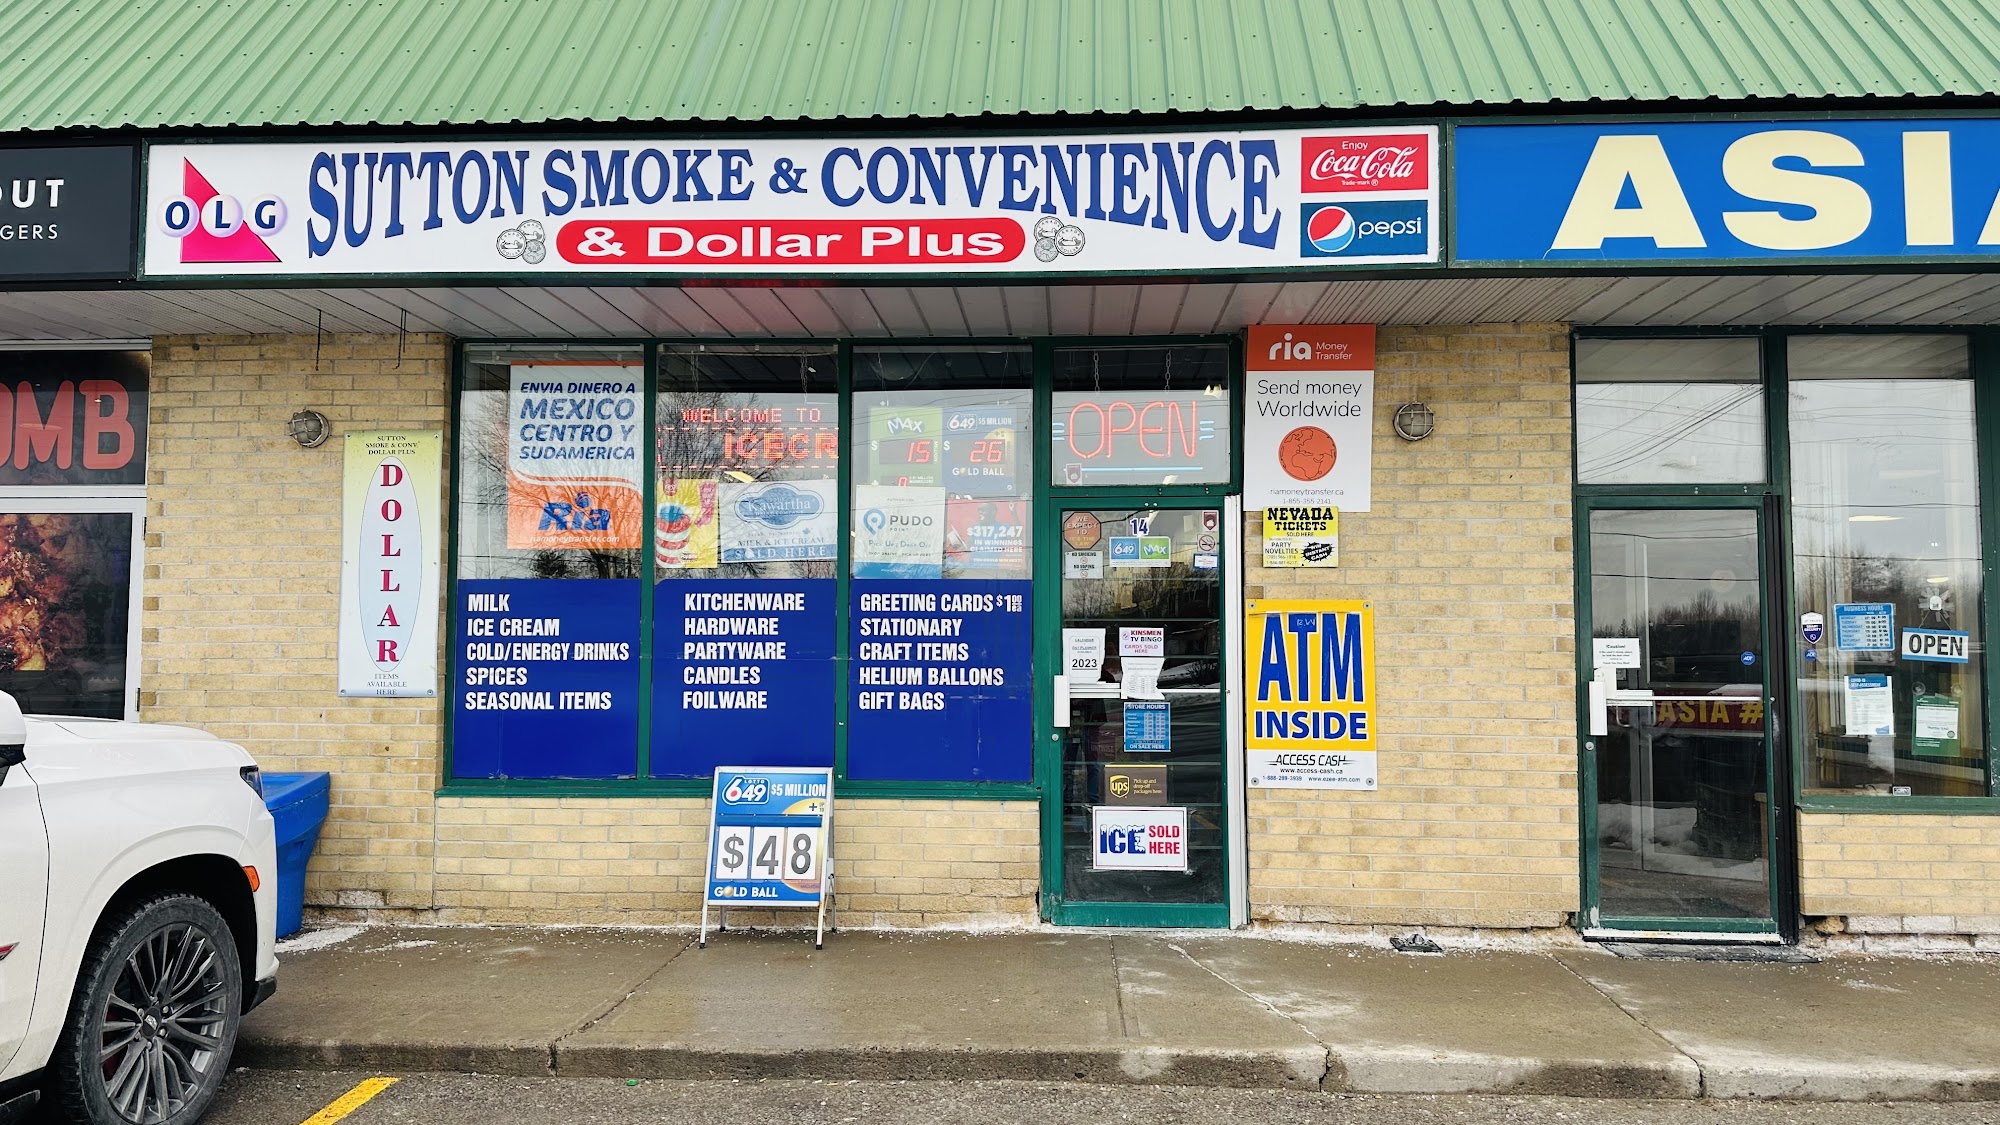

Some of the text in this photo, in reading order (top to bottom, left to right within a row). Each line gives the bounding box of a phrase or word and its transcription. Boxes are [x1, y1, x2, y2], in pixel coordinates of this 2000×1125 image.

[1342, 141, 1368, 150] Enjoy
[1310, 146, 1419, 180] Coca-Cola
[0, 179, 65, 209] UT
[307, 138, 1281, 259] SUTTON SMOKE & CONVENIENCE
[1550, 130, 2000, 250] ASI
[164, 198, 278, 232] OLG
[0, 224, 58, 240] GERS
[1358, 217, 1422, 239] pepsi
[577, 225, 1005, 257] & Dollar Plus
[1269, 332, 1348, 360] ria Money
[1316, 351, 1353, 360] Transfer
[520, 382, 636, 394] ENVIA DINERO A
[1257, 380, 1363, 398] Send money
[519, 397, 636, 420] MEXICO
[681, 408, 821, 423] WELCOME TO
[1257, 400, 1362, 417] Worldwide
[0, 379, 135, 470] MB
[887, 416, 923, 434] MAX
[986, 417, 1012, 426] MILLION
[1069, 400, 1197, 459] OPEN
[519, 423, 635, 442] CENTRO Y
[519, 445, 636, 461] SUDAMERICA
[907, 440, 931, 463] 15
[969, 440, 1003, 463] 26
[982, 467, 1005, 476] BALL
[1270, 488, 1344, 496] riamoneytransfer.ca
[537, 491, 612, 531] Ria
[748, 498, 812, 513] Kawartha
[1267, 507, 1334, 521] NEVADA
[890, 515, 933, 527] PUDO
[1130, 518, 1149, 535] 14
[1274, 522, 1327, 531] TICKETS
[529, 535, 620, 544] riamoneytransfer.com
[791, 536, 825, 544] CREAM
[966, 526, 1024, 540] $317,247
[785, 546, 827, 558] HERE
[1114, 542, 1135, 554] 649
[374, 463, 405, 664] DOLLAR
[467, 593, 510, 612] MILK
[684, 592, 806, 612] KITCHENWARE
[860, 594, 937, 612] GREETING
[940, 594, 994, 612] CARDS
[467, 618, 560, 637] ICE CREAM
[684, 617, 780, 636] HARDWARE
[860, 617, 963, 637] STATIONARY
[466, 642, 630, 661] COLD/ENERGY DRINKS
[684, 642, 787, 660] PARTYWARE
[859, 642, 970, 662] CRAFT ITEMS
[1908, 633, 1964, 657] OPEN
[1072, 658, 1098, 668] 2023
[1257, 612, 1365, 703] ATM
[466, 667, 528, 686] SPICES
[683, 666, 761, 685] CANDLES
[859, 666, 1004, 686] HELIUM BALLONS
[465, 691, 612, 710] SEASONAL ITEMS
[682, 690, 768, 710] FOILWARE
[858, 691, 945, 710] GIFT BAGS
[1657, 700, 1730, 724] ASIA
[1255, 710, 1368, 740] INSIDE
[1275, 754, 1346, 766] ACCESS CASH
[726, 778, 826, 802] 649 $5 MILLION
[1112, 782, 1128, 794] ups
[1100, 824, 1180, 854] ICE SOLD
[1149, 842, 1180, 854] HERE
[752, 886, 778, 898] BALL
